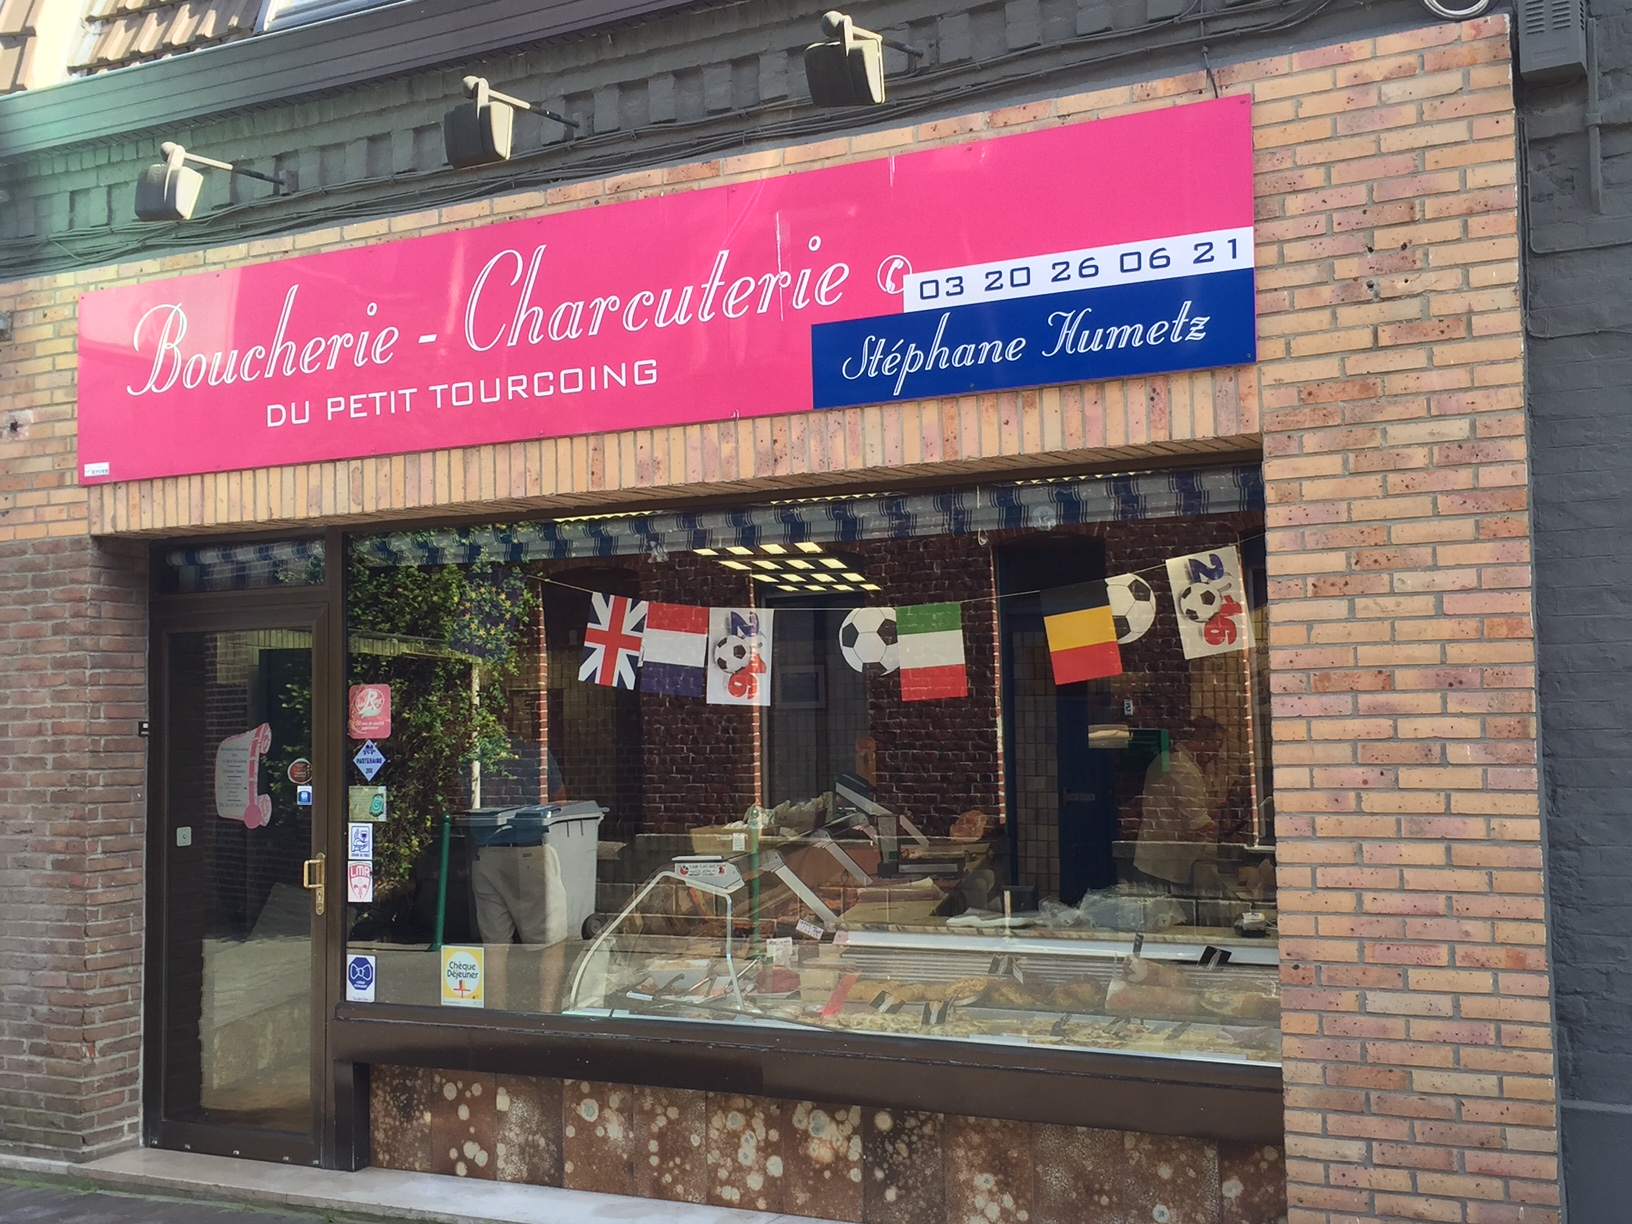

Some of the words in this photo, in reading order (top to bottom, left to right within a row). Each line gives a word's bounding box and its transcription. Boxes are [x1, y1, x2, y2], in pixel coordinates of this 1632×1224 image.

[919, 275, 964, 300] 03
[984, 266, 1031, 292] 20
[1051, 256, 1099, 283] 26
[1119, 247, 1171, 274] 06
[1192, 238, 1239, 264] 21
[126, 284, 399, 396] Boucherie
[464, 236, 850, 352] Charcuterie
[842, 311, 1026, 396] Stéphane
[1041, 301, 1211, 357] Humetz
[266, 400, 310, 428] DU
[327, 388, 418, 421] PETIT
[429, 358, 659, 409] TOURCOING
[350, 865, 370, 878] LMR
[446, 969, 479, 980] Déjeuner
[449, 961, 476, 971] Chèque
